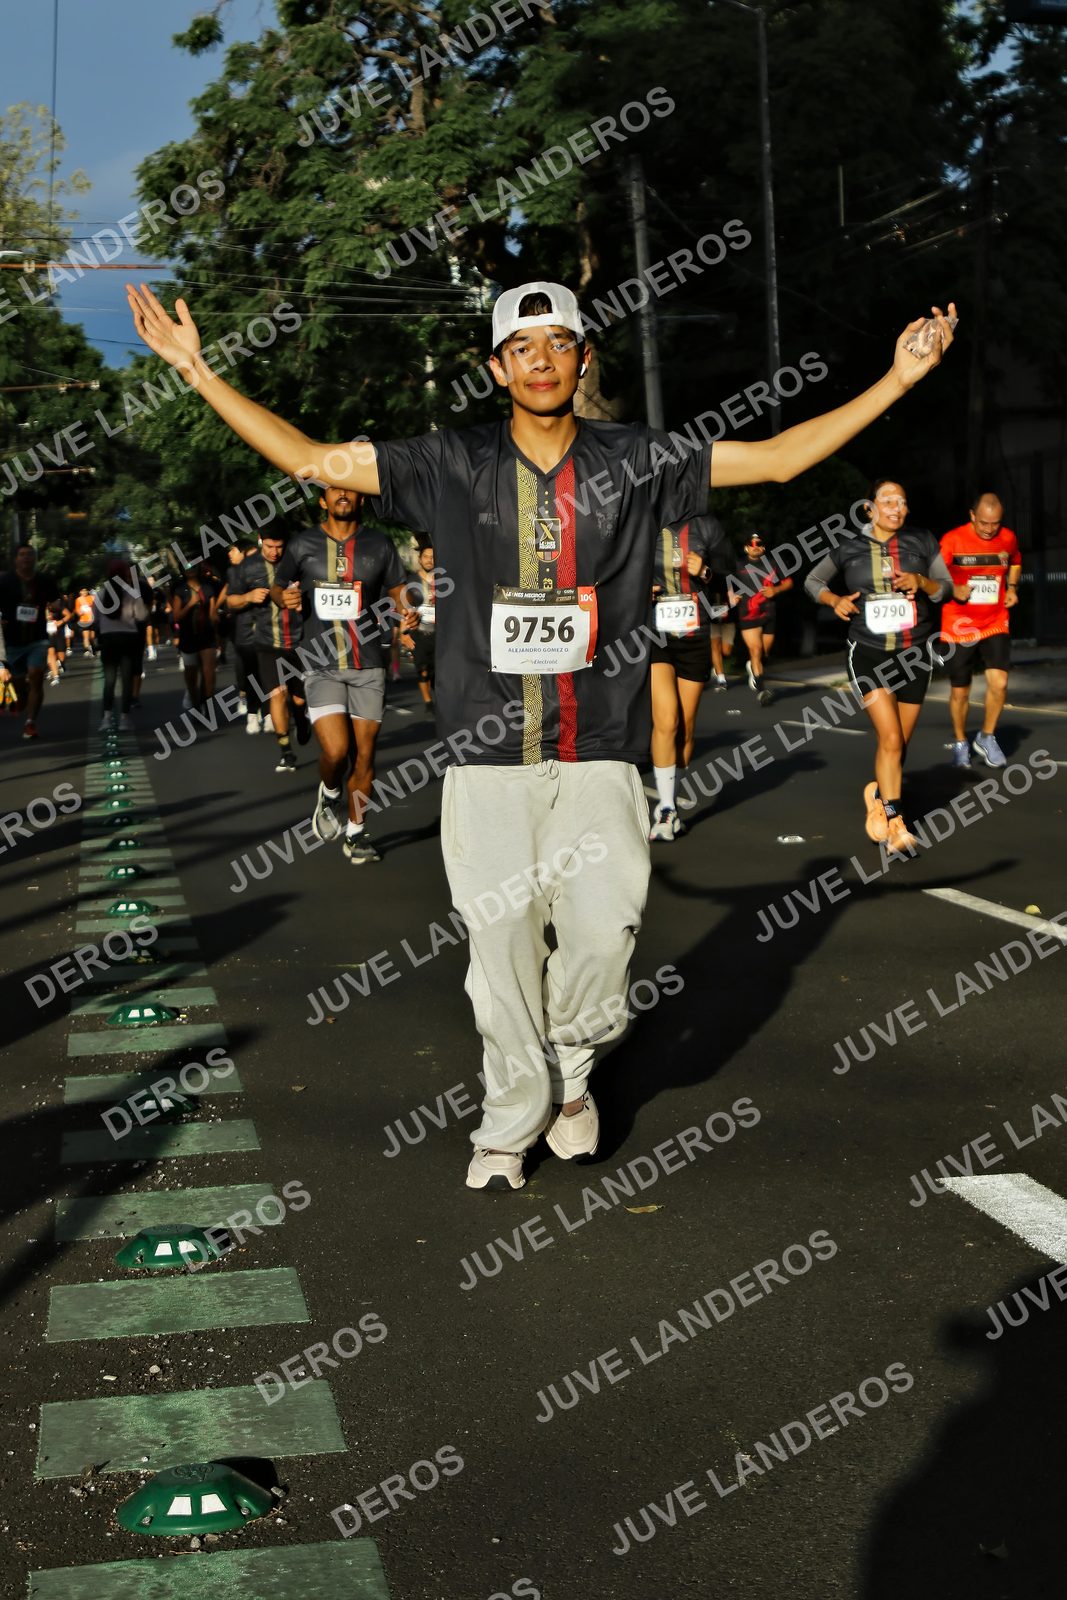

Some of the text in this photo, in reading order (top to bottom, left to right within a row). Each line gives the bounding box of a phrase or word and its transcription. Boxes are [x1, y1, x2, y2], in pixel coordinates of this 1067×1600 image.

[321, 594, 351, 606] 9154
[660, 605, 695, 618] 12972
[873, 605, 906, 618] 9790
[504, 615, 575, 643] 9756
